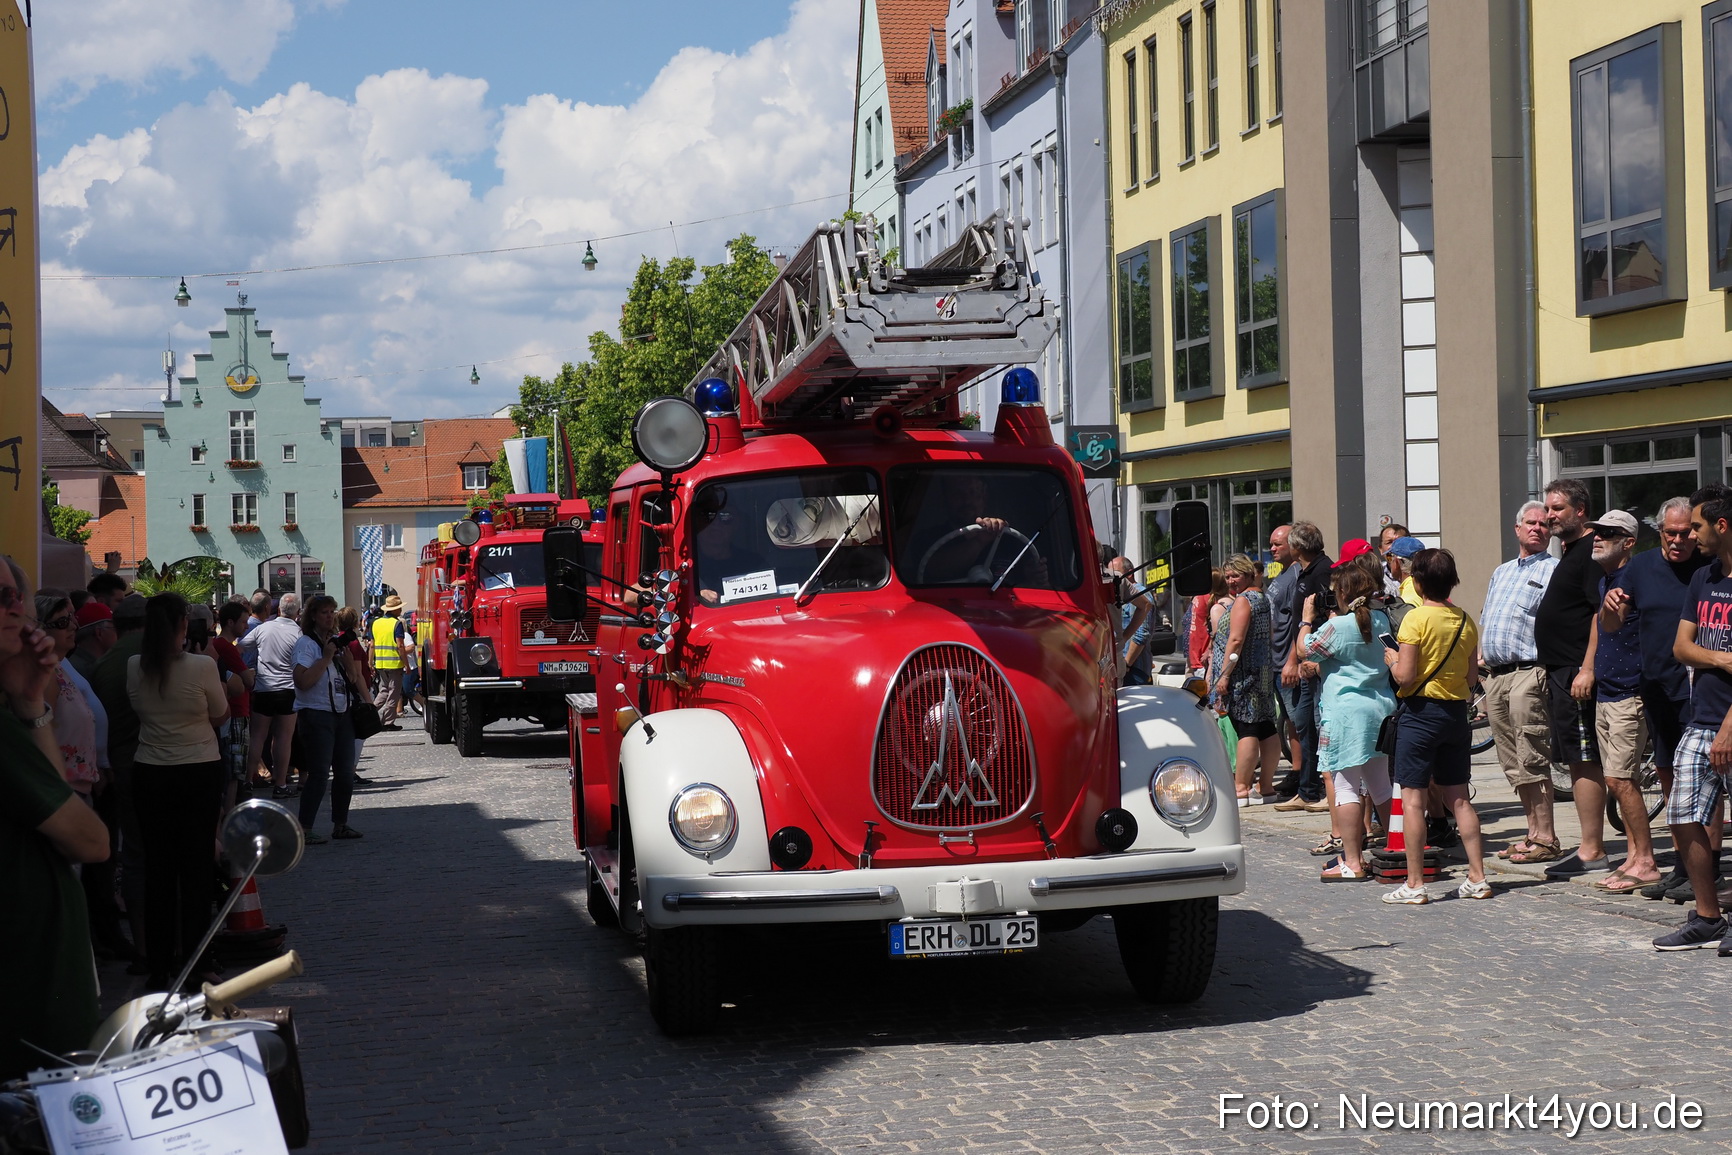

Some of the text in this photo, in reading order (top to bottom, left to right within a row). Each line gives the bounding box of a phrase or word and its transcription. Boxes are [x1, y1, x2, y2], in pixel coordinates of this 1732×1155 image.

[488, 546, 512, 557] 21/1
[732, 583, 768, 595] 74/31/2
[544, 663, 588, 672] NM R 1962H
[904, 925, 953, 951] ERH
[969, 922, 1001, 947] DL
[1006, 920, 1036, 945] 25
[145, 1067, 223, 1120] 260
